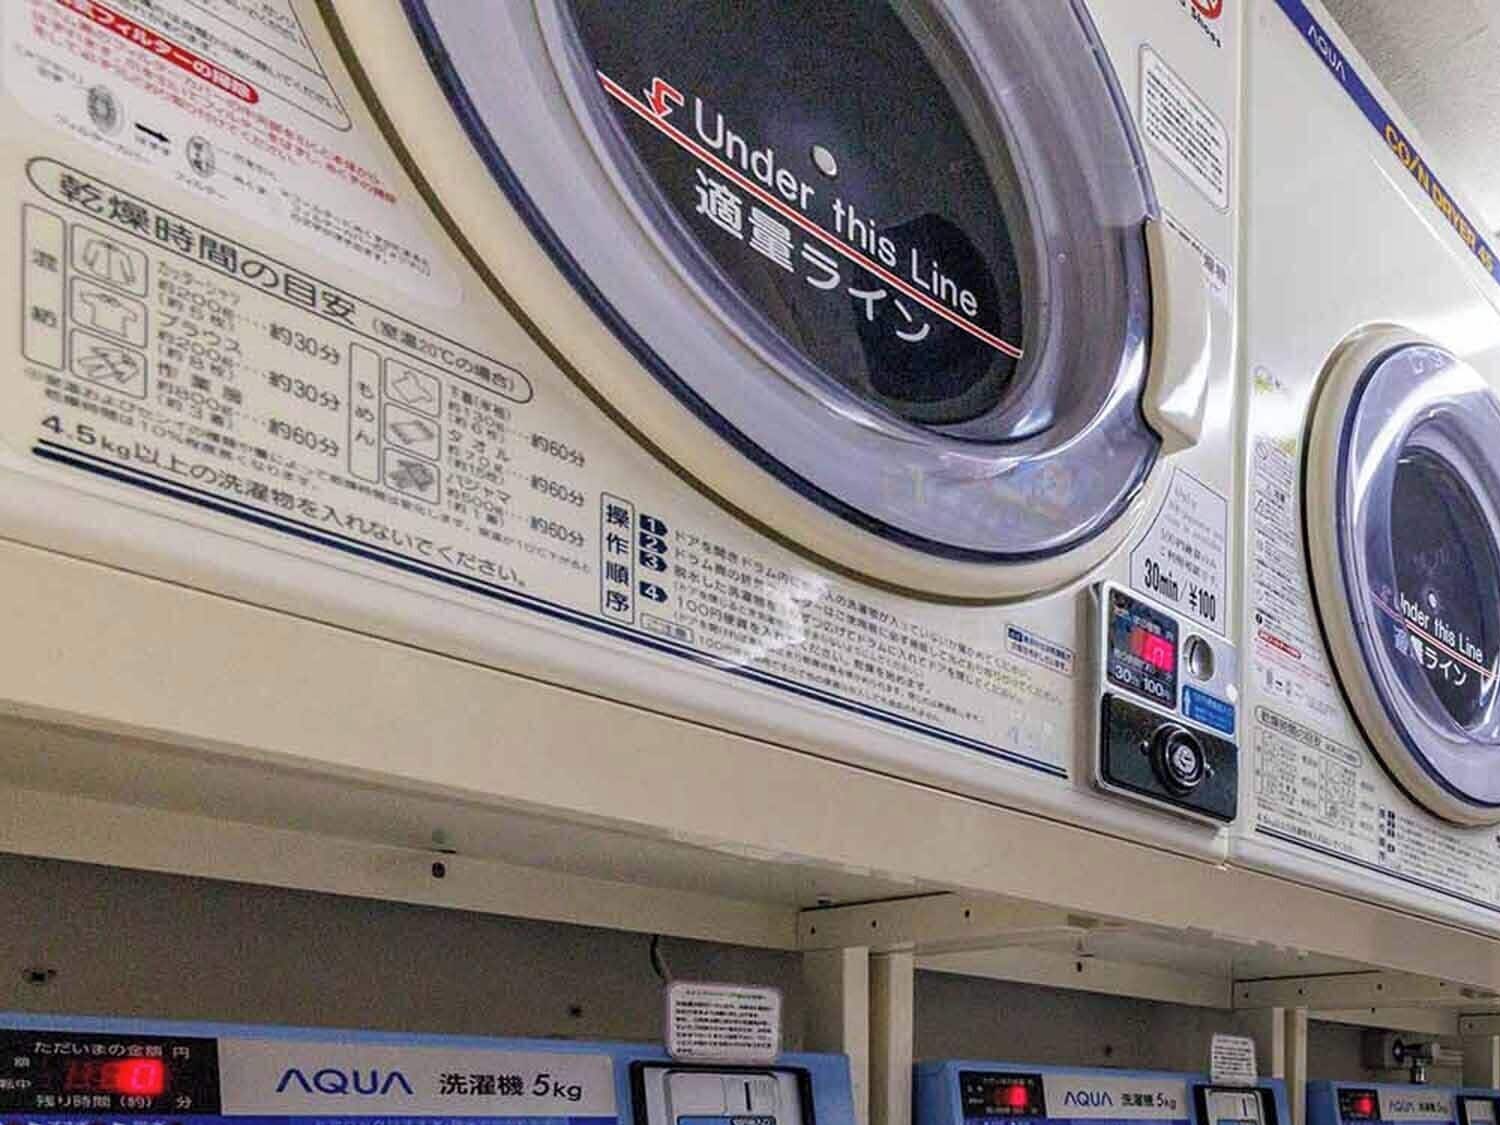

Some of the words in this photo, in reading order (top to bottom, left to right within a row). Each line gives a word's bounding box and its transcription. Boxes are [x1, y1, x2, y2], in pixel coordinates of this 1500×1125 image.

[1306, 24, 1348, 81] AQUA
[694, 97, 814, 209] Under
[832, 199, 896, 267] this
[911, 248, 979, 318] Line
[1384, 124, 1432, 193] COIN
[1431, 183, 1478, 248] DRYER
[59, 172, 357, 326] 乾燥時間の目安
[694, 168, 931, 342] 適量ライン
[268, 322, 341, 367] 約30分
[267, 369, 341, 412] 約30分
[355, 381, 377, 448] もめん
[267, 417, 340, 458] 約60分
[530, 431, 586, 468] 約60分
[41, 413, 528, 588] 4.5kg以上の洗濯物を入れないでください。
[529, 473, 585, 508] 約60分
[529, 514, 585, 548] 約60分
[605, 501, 632, 614] 操作順序
[1433, 616, 1458, 647] this
[1457, 630, 1484, 664] Line
[34, 1041, 163, 1058] ただいまの金額
[172, 1046, 191, 1060] 円
[175, 1096, 193, 1110] 分
[275, 1067, 414, 1098] AQUA
[439, 1072, 525, 1098] 洗濯機
[531, 1072, 583, 1103] 5kg
[1063, 1089, 1113, 1108] AQUA
[1156, 1091, 1177, 1111] 5kg
